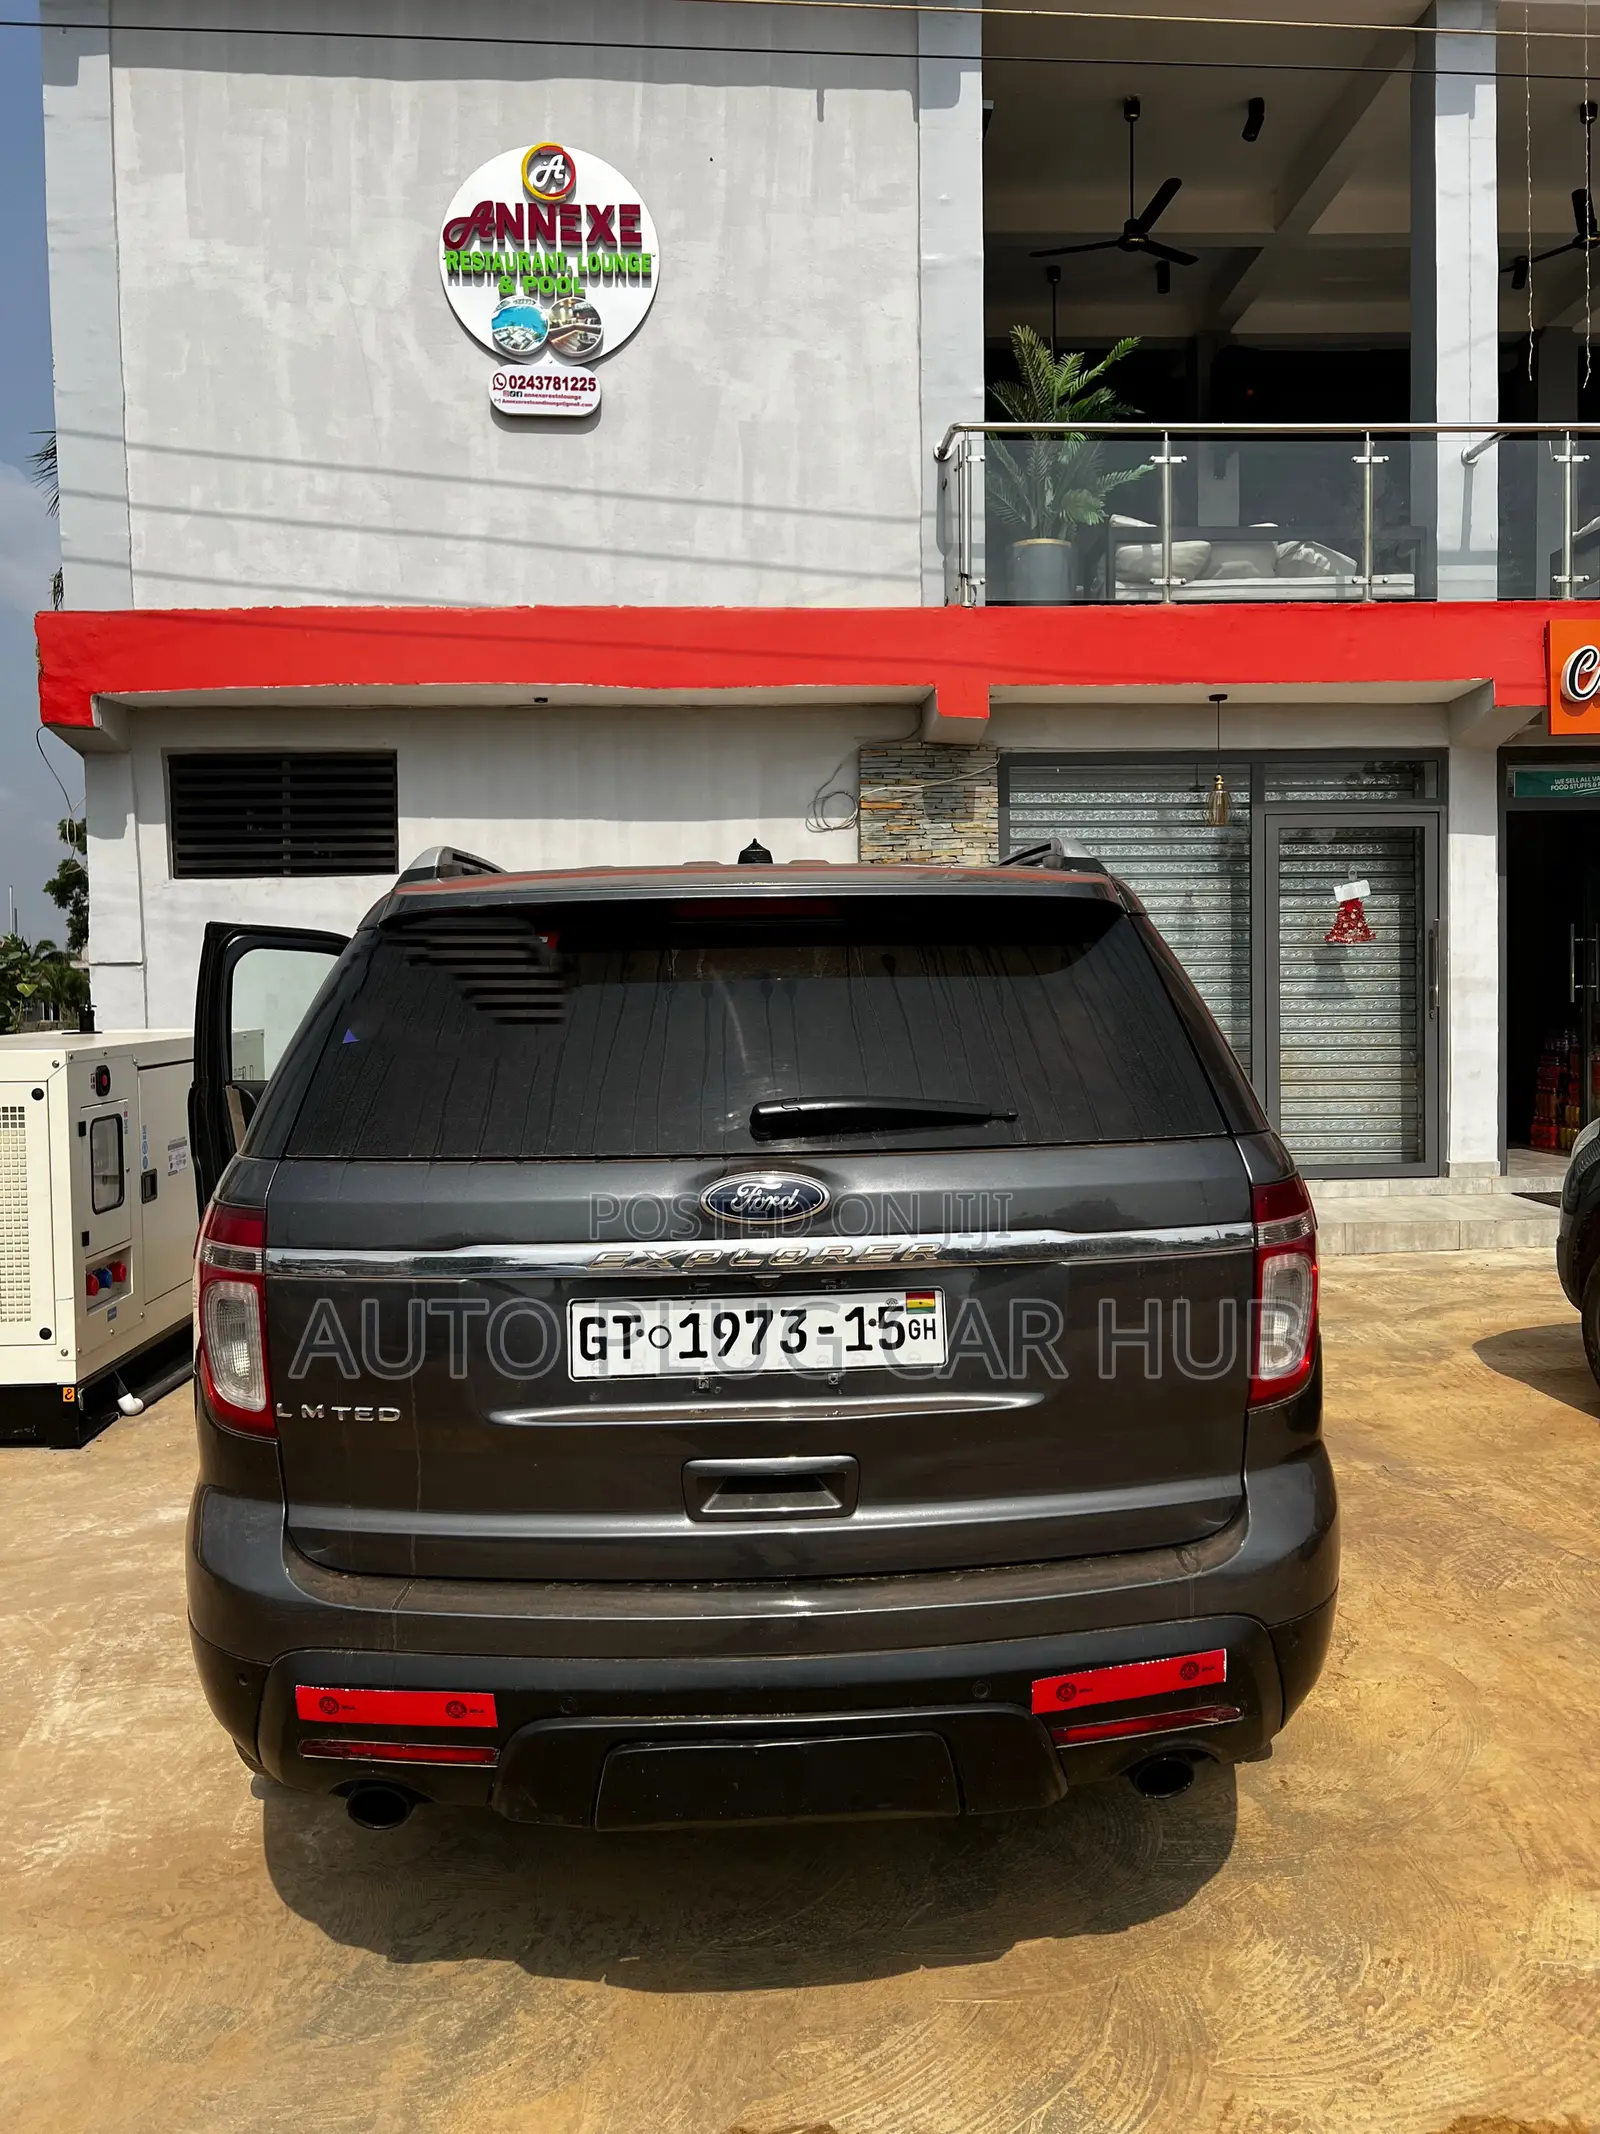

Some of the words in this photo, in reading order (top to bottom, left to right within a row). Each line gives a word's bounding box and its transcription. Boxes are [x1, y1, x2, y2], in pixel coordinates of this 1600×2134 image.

[442, 200, 642, 250] ANNEXE
[578, 252, 652, 273] LOUNGE
[498, 275, 517, 295] &
[523, 275, 586, 295] POOL
[508, 374, 597, 392] 0243781225
[730, 1182, 800, 1212] Ford
[587, 1242, 943, 1270] EXPLORER
[908, 1318, 937, 1341] GH
